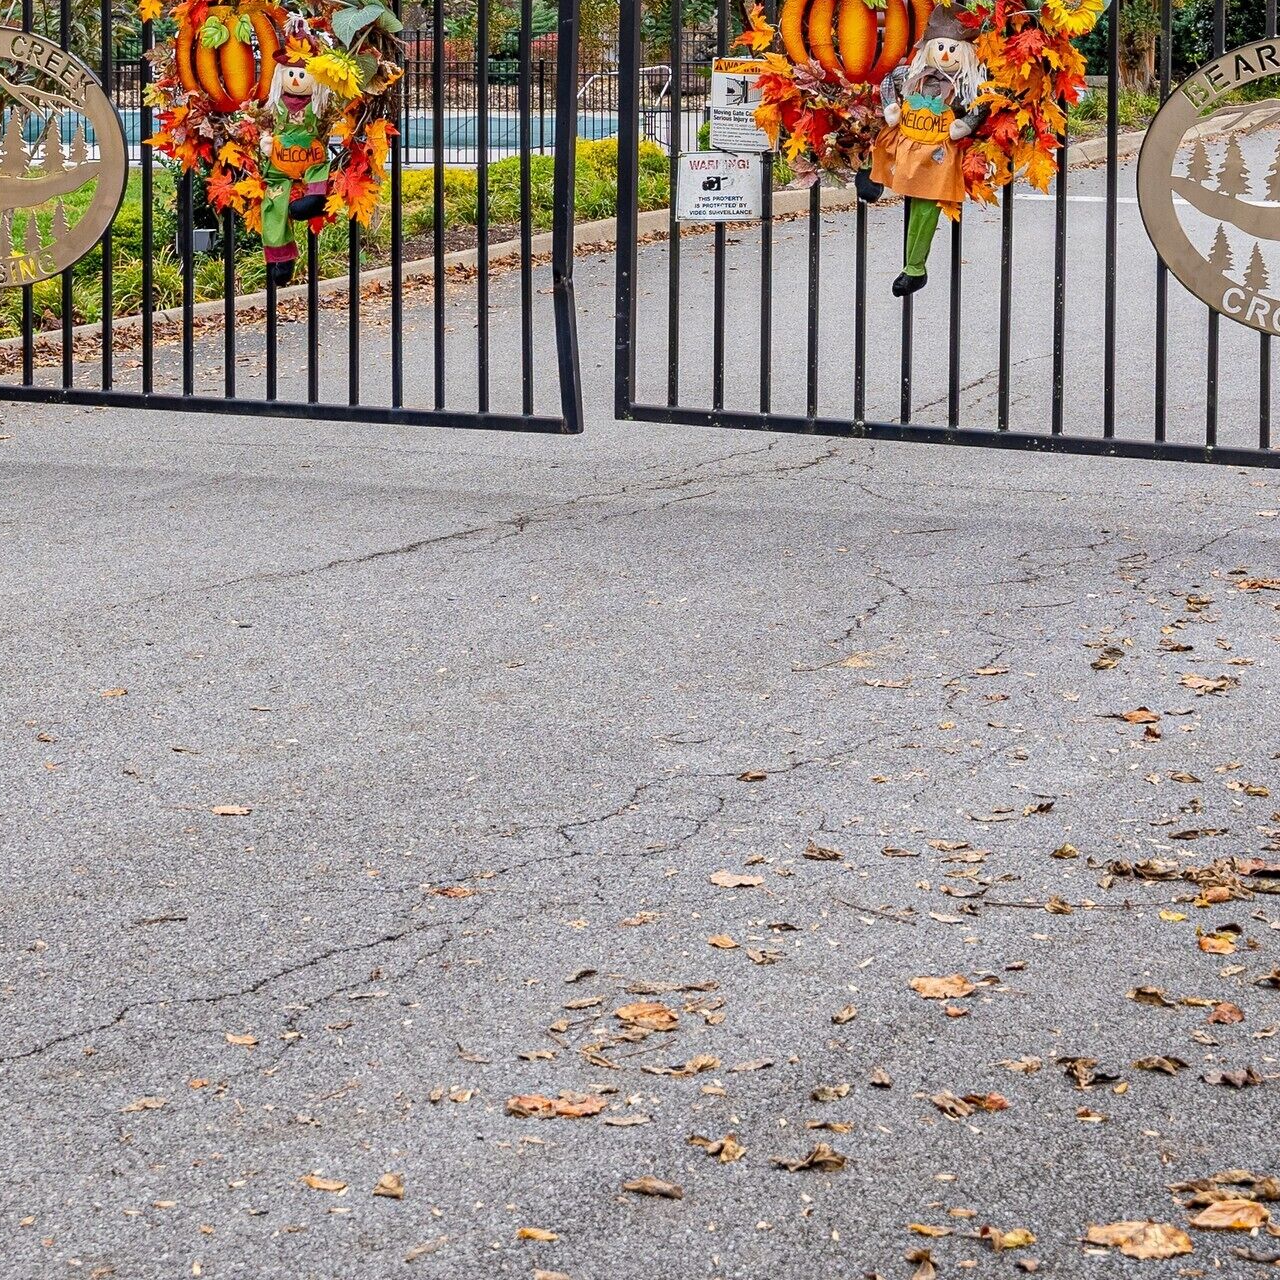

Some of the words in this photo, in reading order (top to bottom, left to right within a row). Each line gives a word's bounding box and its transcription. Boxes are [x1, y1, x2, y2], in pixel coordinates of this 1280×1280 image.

[10, 35, 95, 101] CREEK
[713, 109, 731, 117] Moving
[713, 114, 732, 122] Serious
[900, 111, 948, 133] WELCOME
[274, 146, 323, 162] WELCOME
